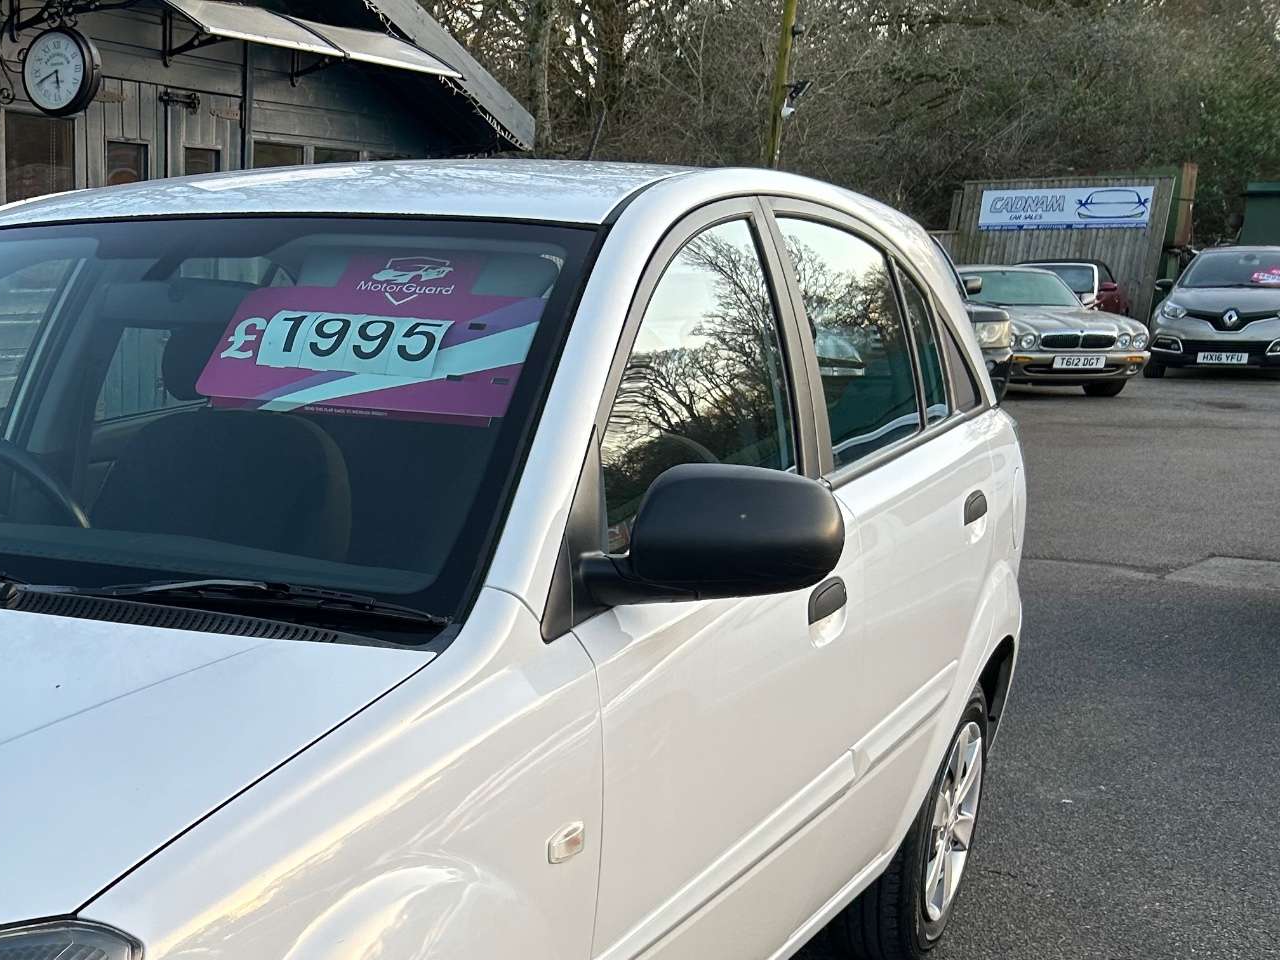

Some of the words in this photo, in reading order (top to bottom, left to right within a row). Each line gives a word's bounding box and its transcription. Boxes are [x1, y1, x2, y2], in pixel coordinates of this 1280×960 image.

[989, 195, 1065, 213] CADNAM
[356, 280, 456, 295] MotorGuard
[220, 315, 443, 362] £1995
[1060, 357, 1080, 367] T612
[1225, 353, 1243, 362] YFU
